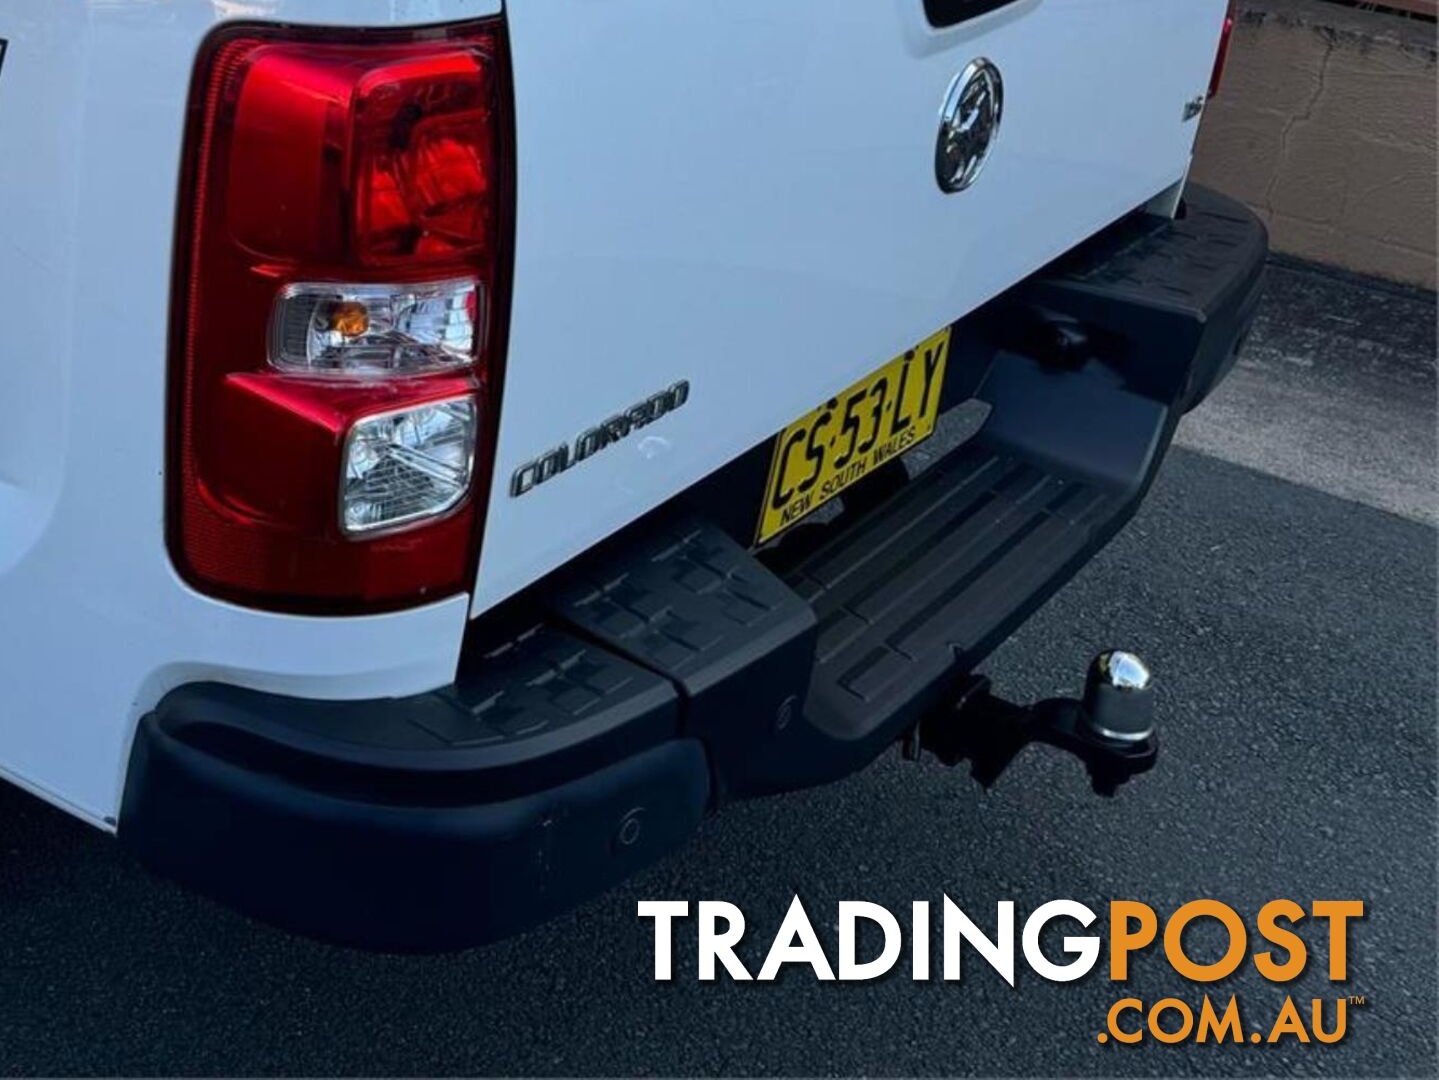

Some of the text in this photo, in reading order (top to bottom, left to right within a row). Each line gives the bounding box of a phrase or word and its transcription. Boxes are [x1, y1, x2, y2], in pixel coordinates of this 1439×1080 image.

[509, 378, 690, 498] COLORADO
[780, 425, 917, 526] NEW SOUTH WALES
